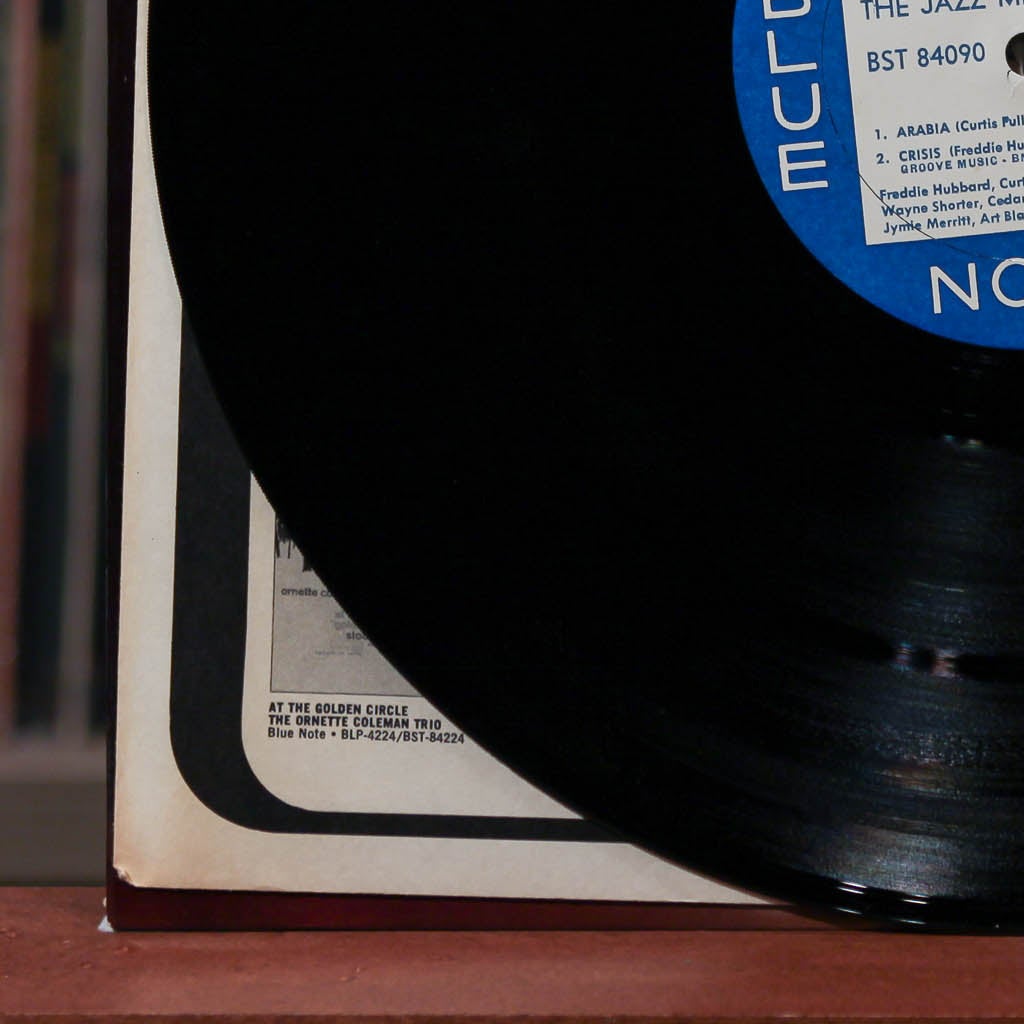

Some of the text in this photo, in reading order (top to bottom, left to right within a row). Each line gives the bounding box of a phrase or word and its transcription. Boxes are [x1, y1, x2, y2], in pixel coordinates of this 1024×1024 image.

[867, 42, 986, 73] BST 84090
[875, 128, 888, 140] 1.
[896, 122, 951, 138] ARABIA
[955, 118, 998, 133] (Curtis
[876, 153, 890, 164] 2.
[899, 147, 941, 162] CRISIS
[949, 140, 1003, 158] (Freddie
[900, 159, 953, 174] GROOVE
[957, 156, 998, 169] MUSIC
[880, 185, 929, 201] Freddie
[933, 179, 996, 196] Hubbard,
[881, 202, 929, 219] Wayne
[932, 197, 984, 212] Shorter,
[883, 220, 923, 236] Jymie
[927, 213, 976, 229] Merritt,
[980, 212, 1001, 225] Art
[269, 702, 408, 717] AT THE GOLDEN CIRCLE
[269, 714, 442, 731] THE ORNETTE COLEMAN TRIO
[268, 727, 465, 745] Blue Note BLP-4224/BST-84224
